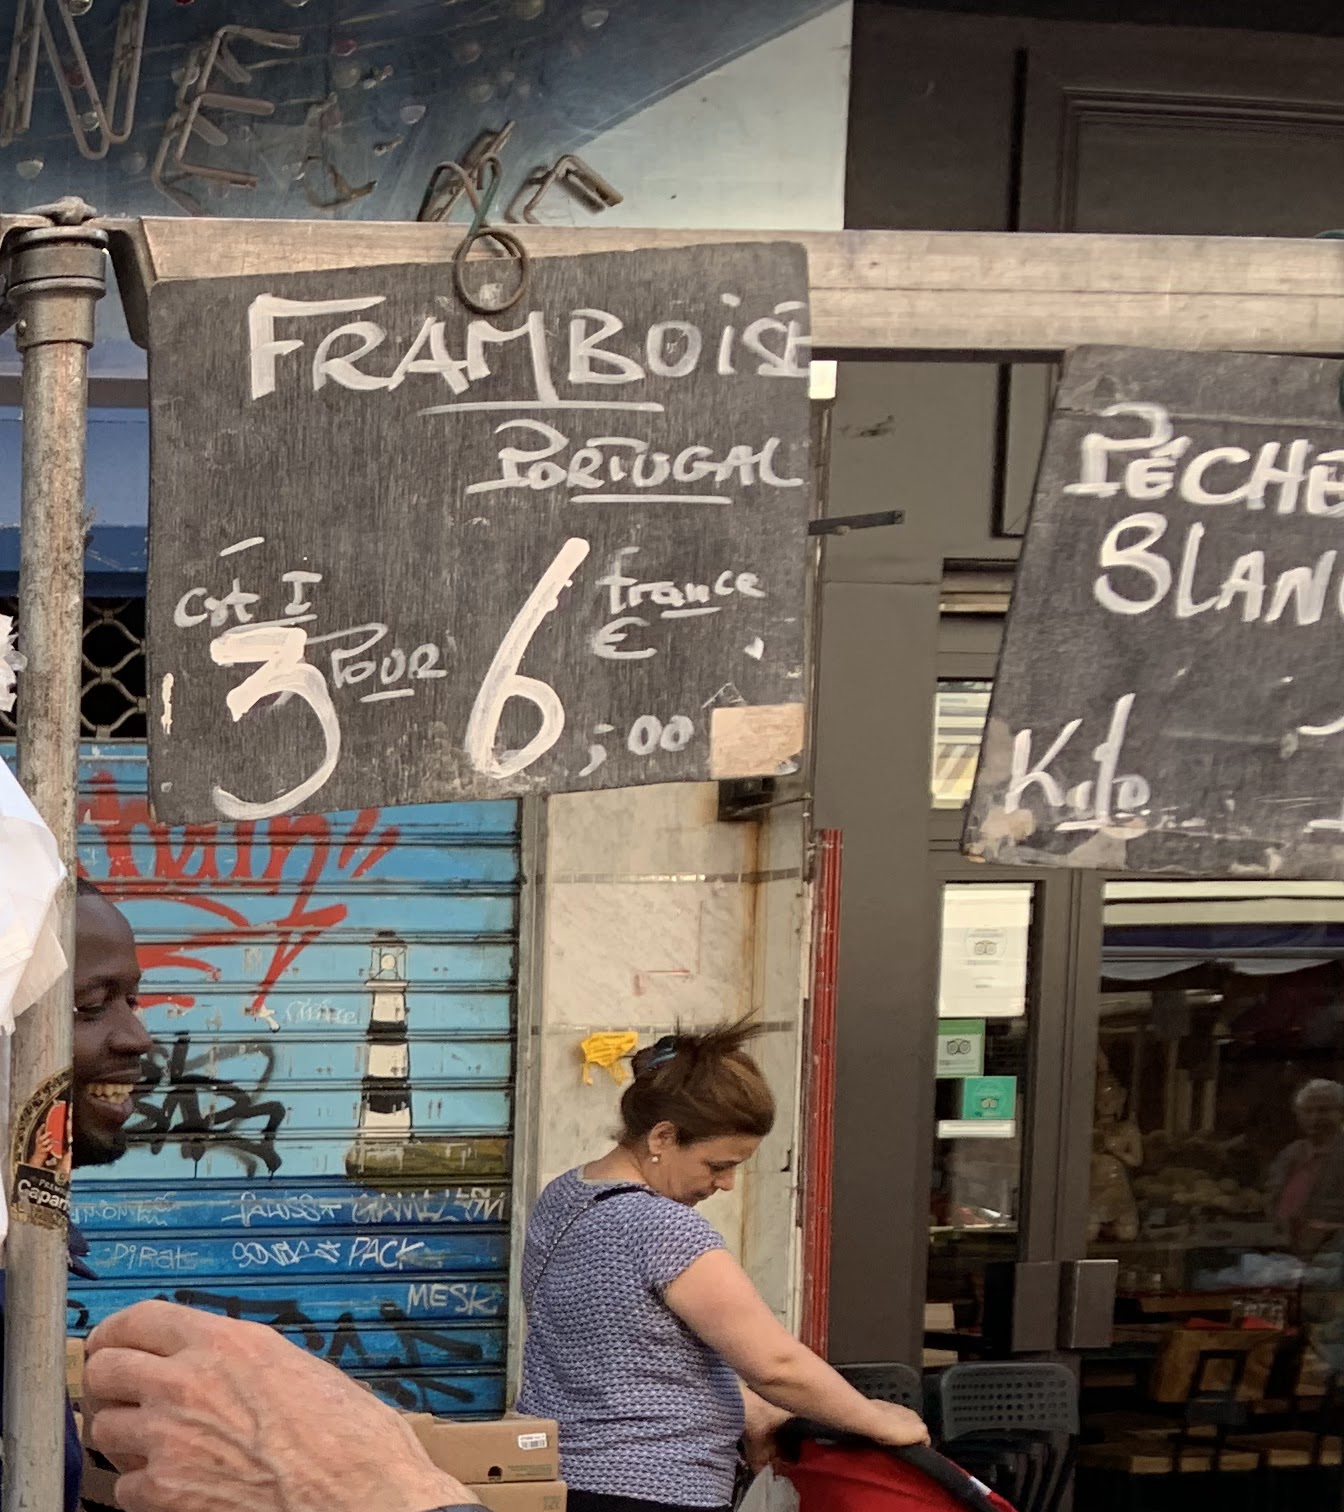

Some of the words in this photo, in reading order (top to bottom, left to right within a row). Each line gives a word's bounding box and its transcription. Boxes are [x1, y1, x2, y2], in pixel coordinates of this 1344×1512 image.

[464, 418, 806, 496] PORTUGAL
[1093, 511, 1344, 626] BLAN
[210, 626, 342, 821] 3
[348, 1236, 425, 1270] PACK
